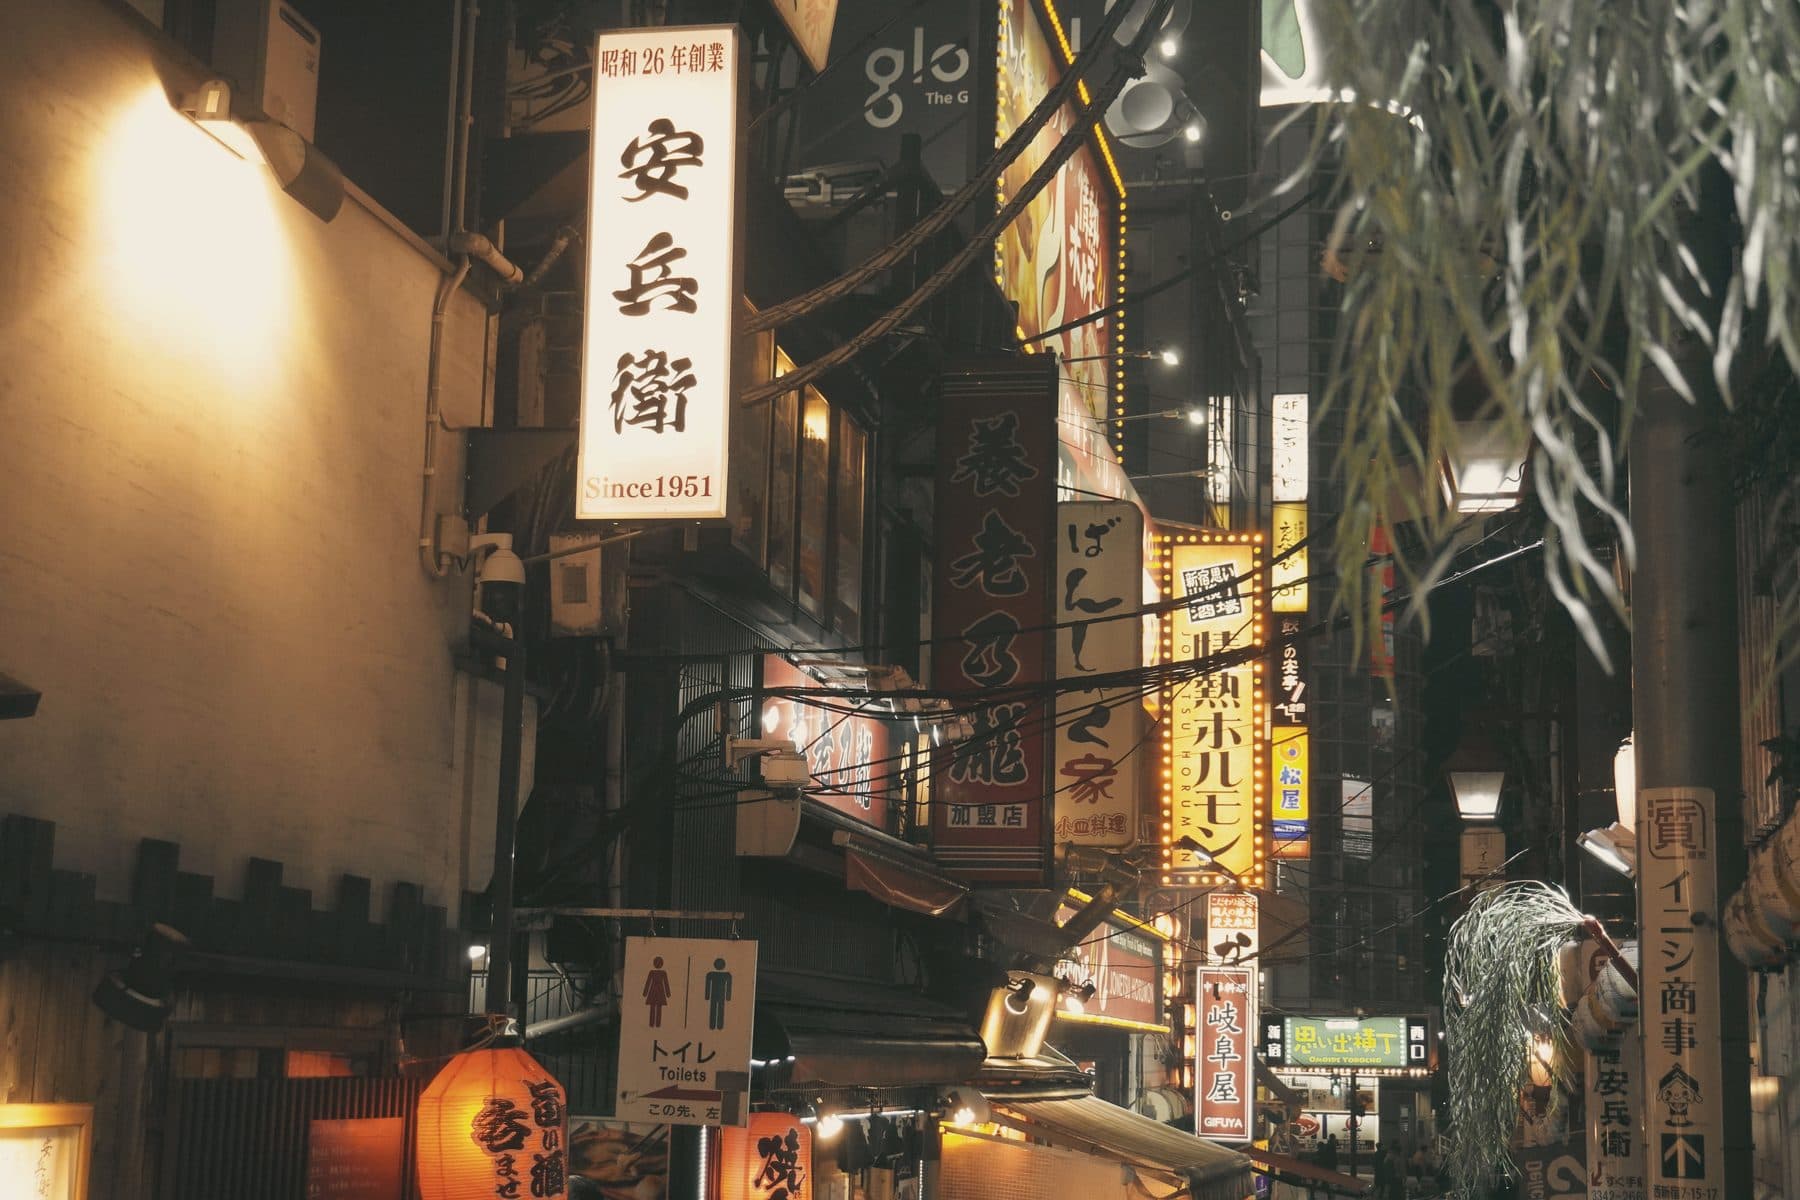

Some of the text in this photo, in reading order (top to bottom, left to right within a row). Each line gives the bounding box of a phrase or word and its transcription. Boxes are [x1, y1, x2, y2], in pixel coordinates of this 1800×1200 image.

[601, 41, 725, 79] 昭和26年創業
[864, 26, 970, 129] glo
[925, 91, 954, 105] The
[609, 118, 704, 435] 安兵衛
[585, 475, 713, 499] Since1951
[1062, 516, 1124, 804] ばんしく家
[1181, 631, 1191, 862] JOTSU HORUMN
[1279, 765, 1301, 809] 松屋
[951, 805, 1023, 827] 加盟店
[1654, 805, 1697, 850] 質
[1659, 868, 1698, 1057] イニシ商事
[652, 1039, 717, 1064] トイレ
[1207, 1001, 1241, 1103] 岐阜屋
[1267, 1024, 1282, 1057] 新宿
[1294, 1025, 1398, 1056] 思い出横丁
[1410, 1025, 1425, 1059] 西口
[659, 1066, 707, 1082] Toilets
[648, 1103, 721, 1120] この先、左
[1203, 1117, 1243, 1129] GIFUYA
